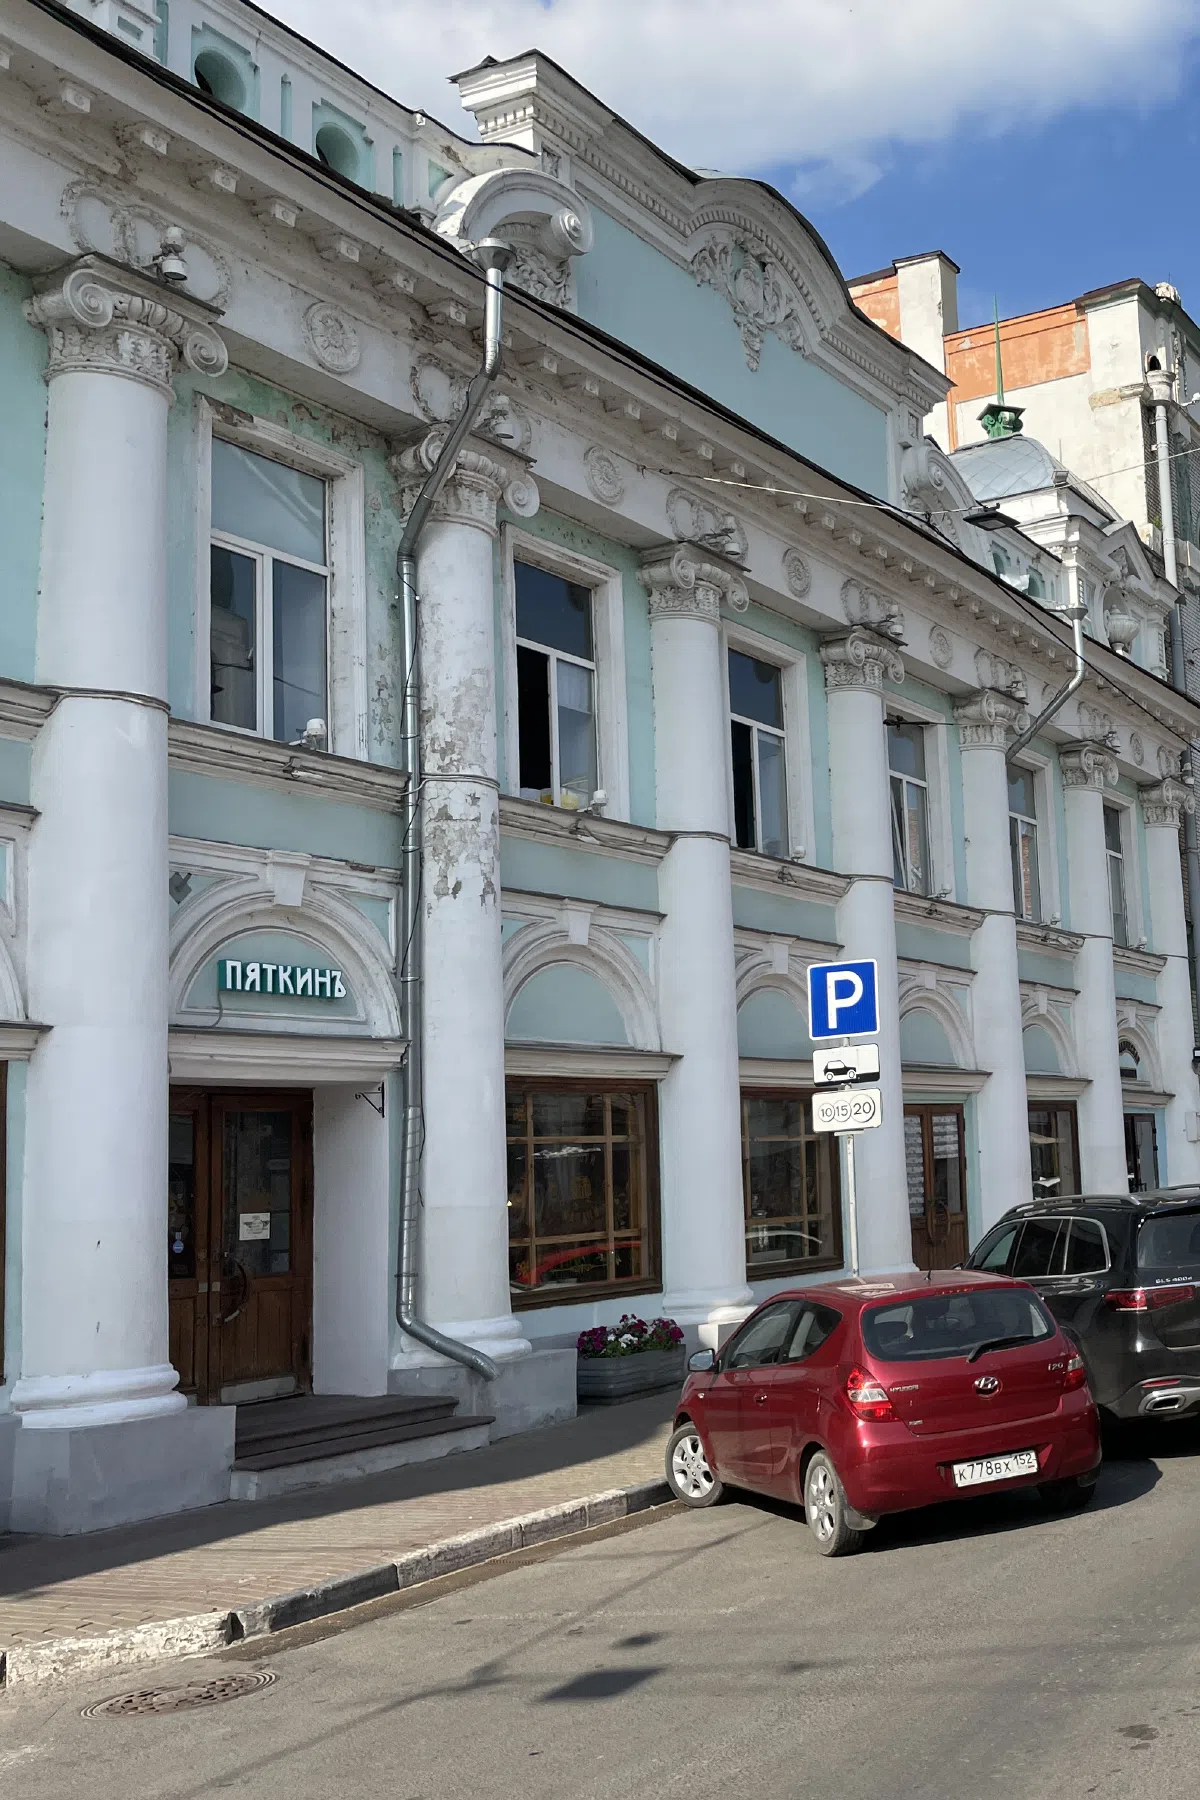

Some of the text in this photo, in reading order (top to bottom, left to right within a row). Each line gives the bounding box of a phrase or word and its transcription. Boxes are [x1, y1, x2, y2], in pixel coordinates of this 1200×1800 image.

[226, 960, 347, 998] ПЯТКИНЪ
[827, 971, 863, 1029] P
[821, 1102, 871, 1117] 10 15 20
[959, 1453, 1033, 1481] К778ВХ 152
